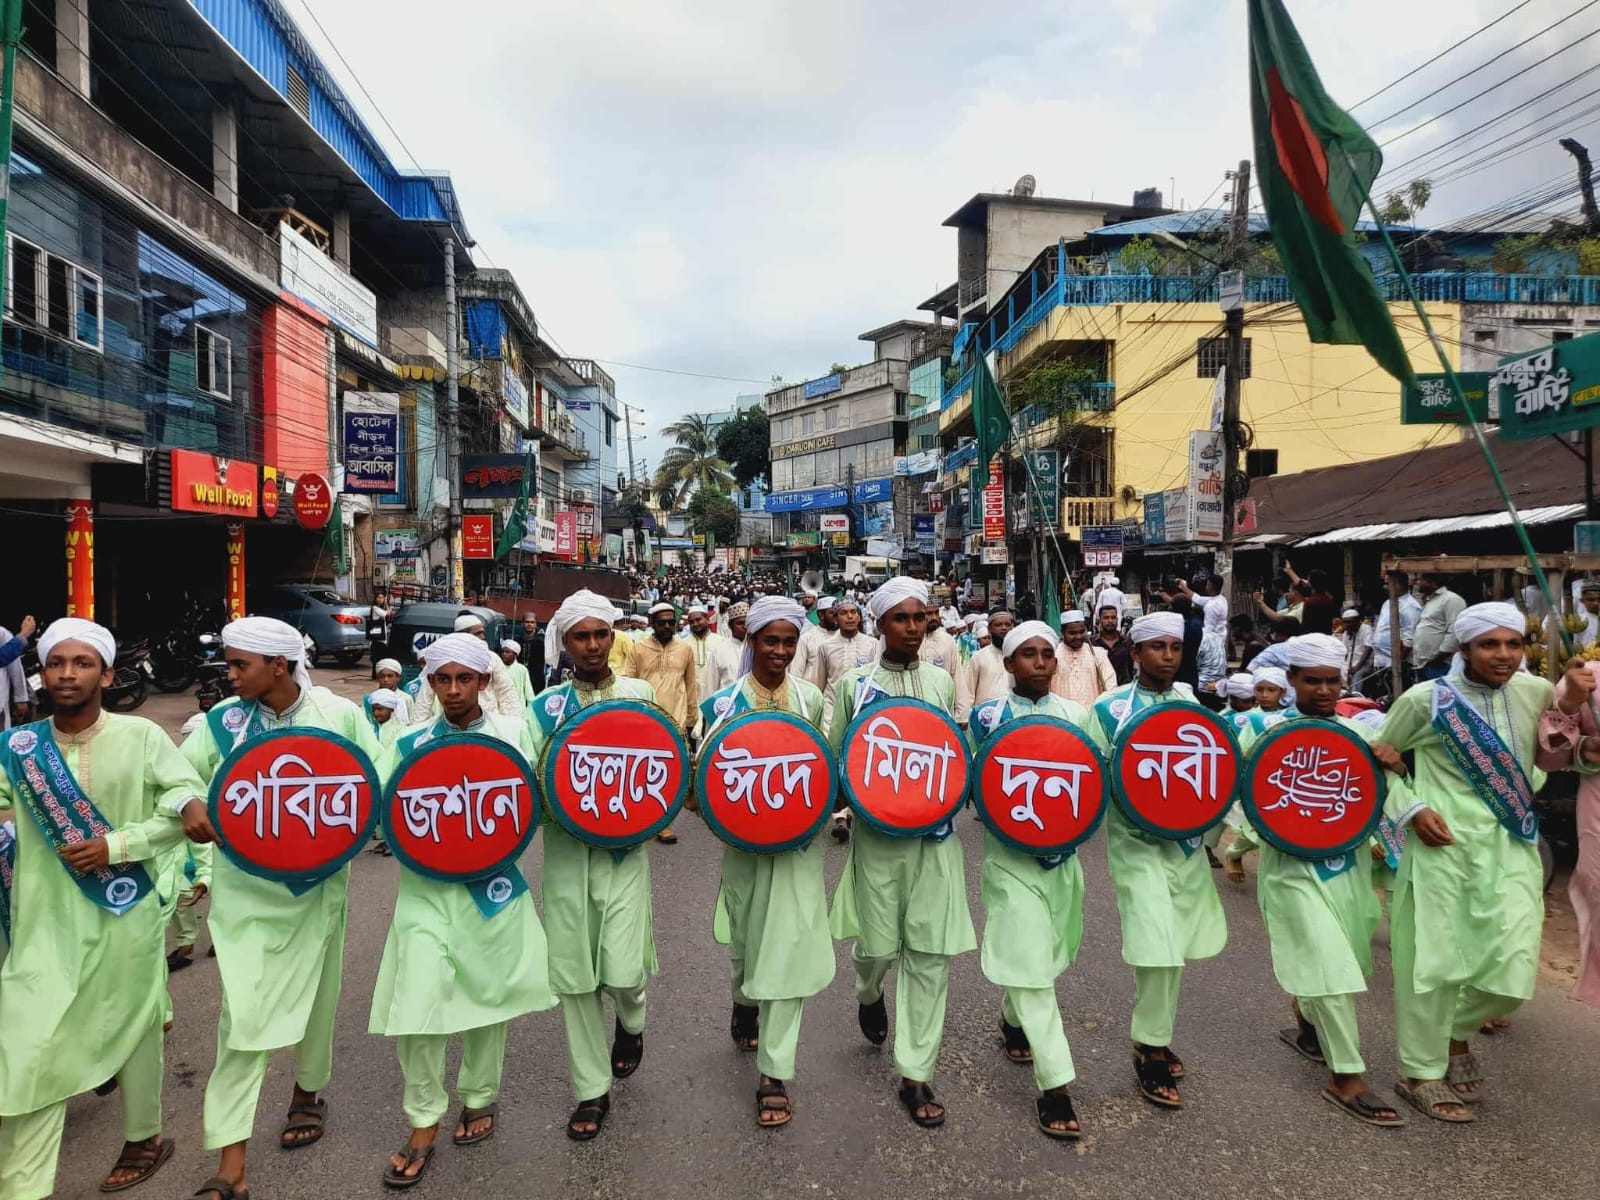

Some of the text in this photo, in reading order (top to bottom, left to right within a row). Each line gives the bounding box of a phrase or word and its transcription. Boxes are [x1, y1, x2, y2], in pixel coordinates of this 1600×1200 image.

[1514, 367, 1571, 415] বাড়ি
[351, 415, 392, 429] হোটেল
[816, 435, 835, 450] CAFE
[347, 456, 395, 475] আবাসিক
[1198, 471, 1224, 497] বাড়ি
[194, 483, 223, 503] Well
[226, 487, 253, 507] Food
[771, 494, 798, 506] SINGER
[227, 542, 242, 593] Well
[567, 743, 675, 821] জুলুছে
[714, 741, 818, 815] ঈদে
[862, 716, 956, 804] মিলা
[1130, 723, 1228, 800] নবী
[224, 752, 368, 840] পবিত্র
[396, 774, 526, 844] জশনে
[993, 755, 1093, 831] দুন
